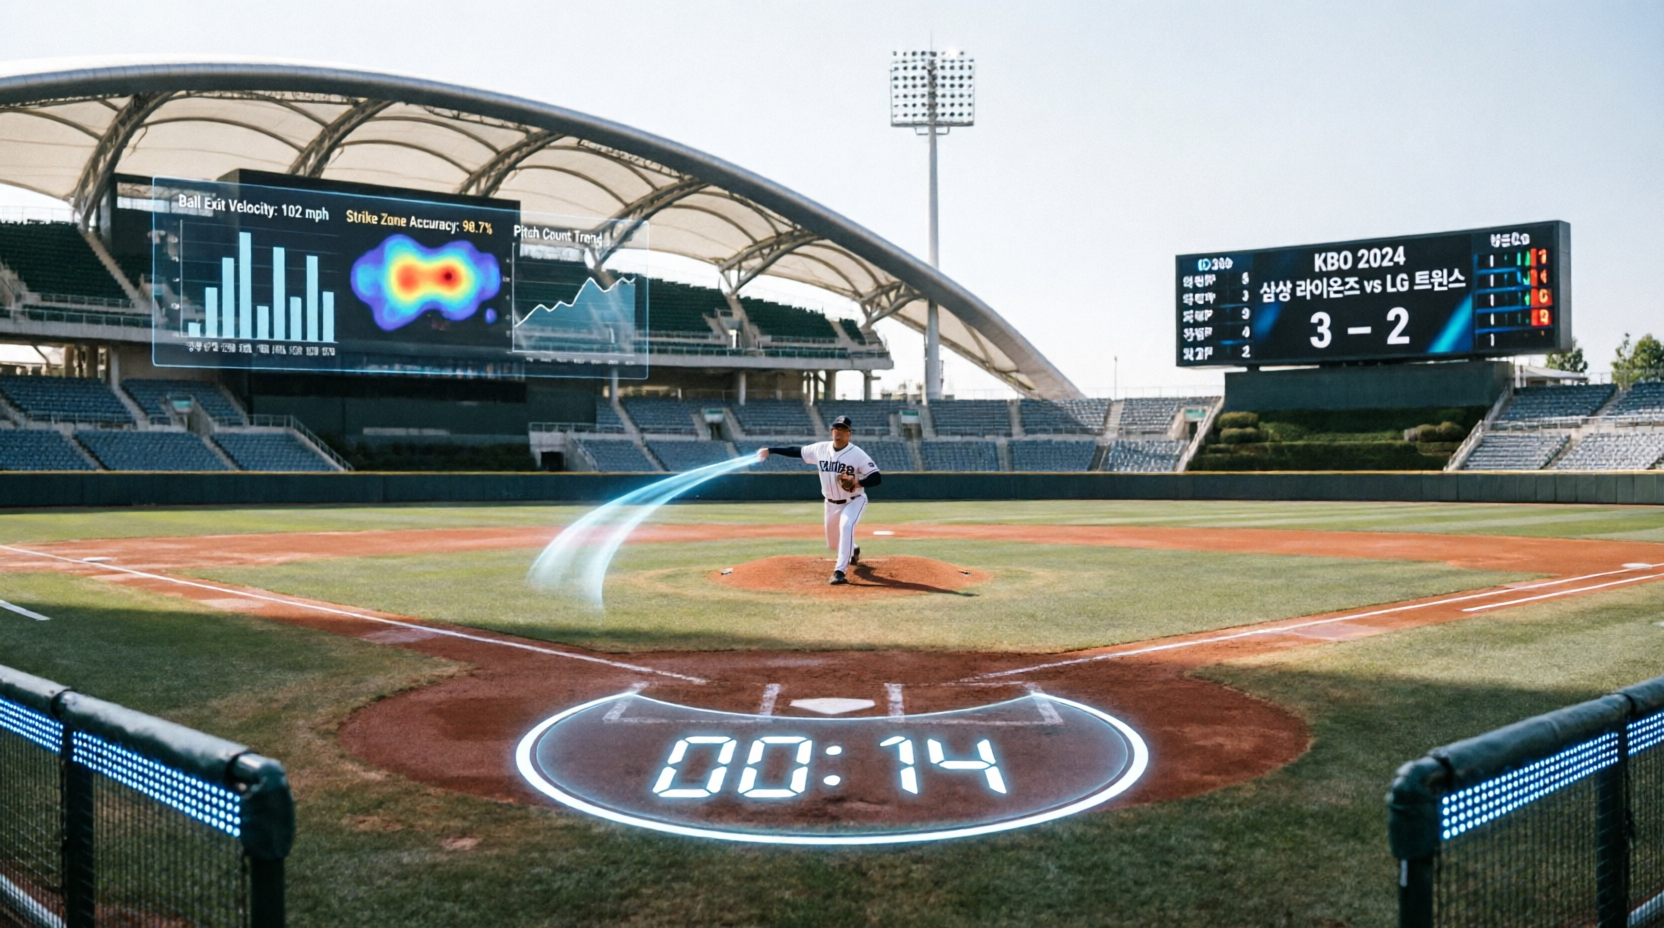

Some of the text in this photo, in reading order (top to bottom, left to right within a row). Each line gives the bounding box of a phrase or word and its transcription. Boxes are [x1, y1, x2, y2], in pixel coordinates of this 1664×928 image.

[178, 193, 330, 223] Ball Exit Velocity: 102 mph
[346, 209, 378, 225] Strike
[380, 213, 407, 227] Zone
[409, 215, 460, 234] Accuracy:
[513, 224, 540, 239] Pitch
[542, 227, 572, 241] Count
[1314, 246, 1406, 272] KBO 2024
[1260, 268, 1466, 303] 삼상 라이온즈 vs LG 트윈스
[1309, 311, 1332, 349] 3
[1386, 306, 1410, 345] 2
